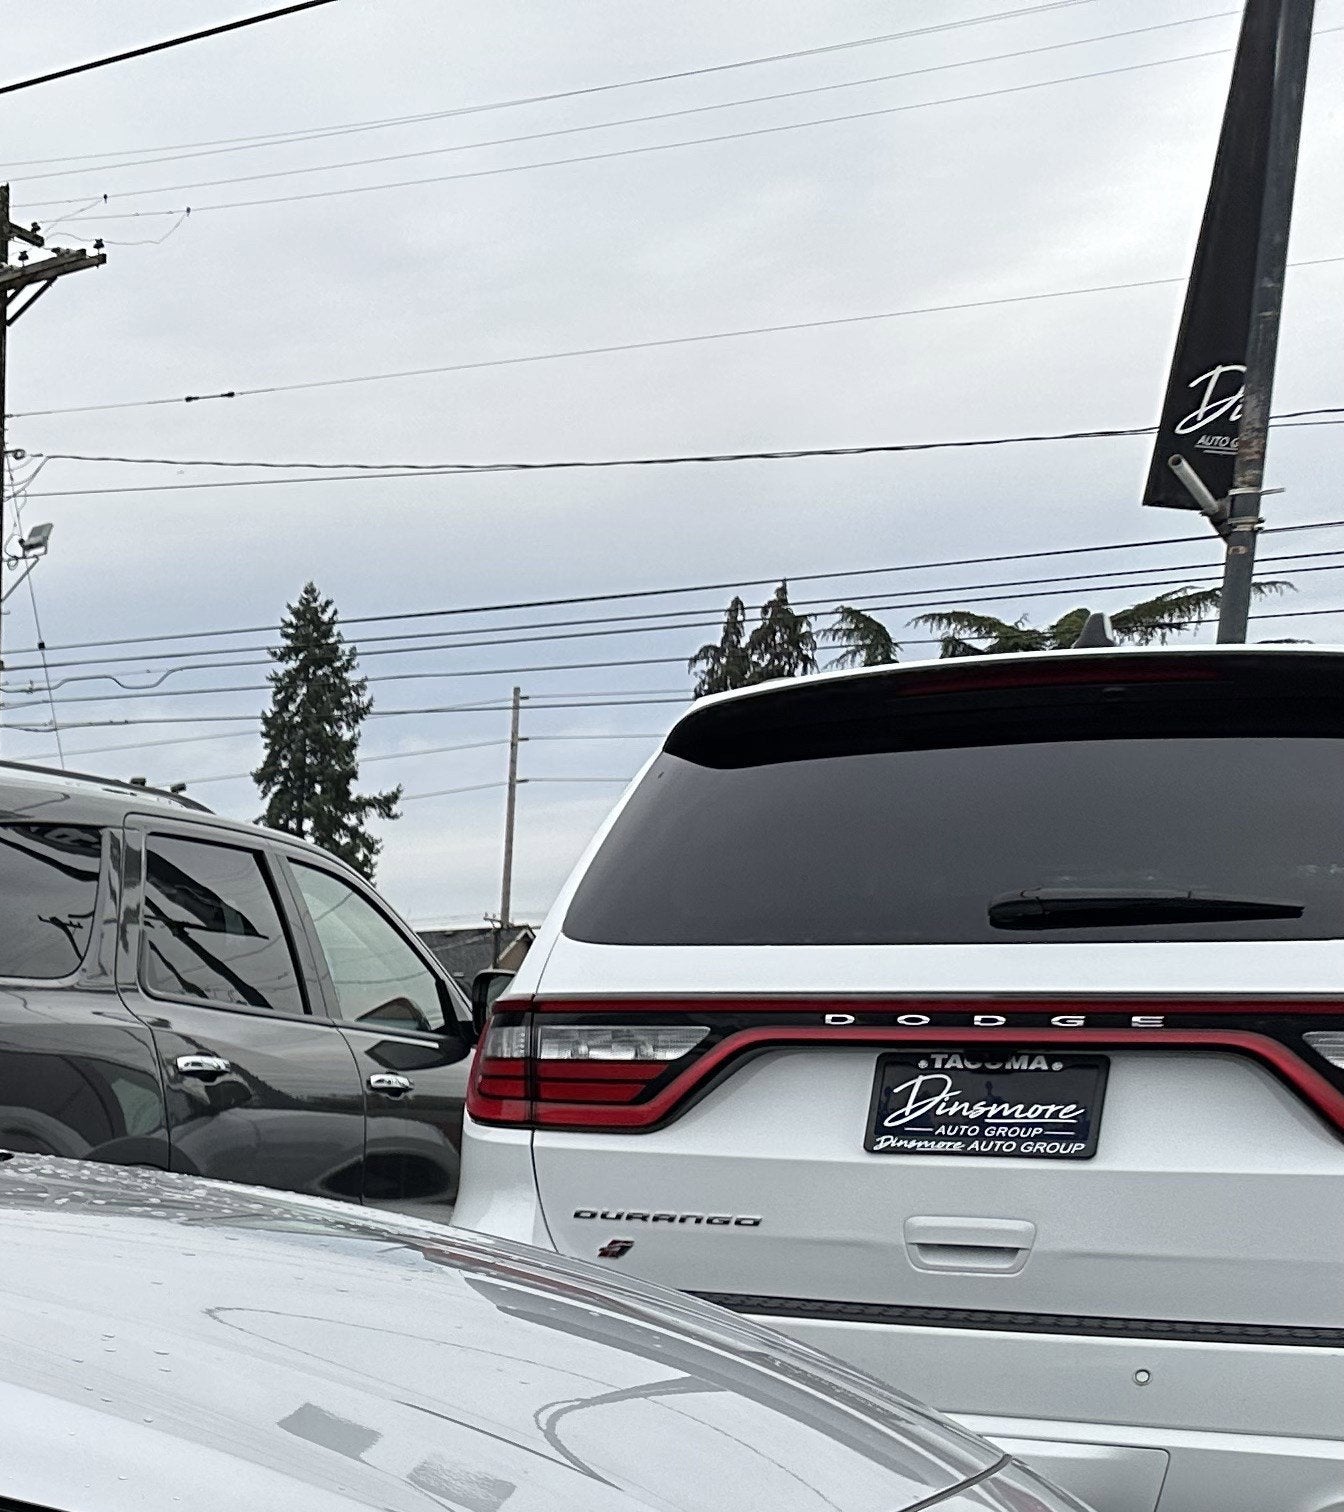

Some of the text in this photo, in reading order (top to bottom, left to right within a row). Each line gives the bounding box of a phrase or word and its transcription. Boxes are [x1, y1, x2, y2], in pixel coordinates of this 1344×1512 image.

[825, 1014, 1164, 1027] DODGE
[884, 1074, 1085, 1127] Dinsmore
[935, 1125, 1044, 1138] AUTO GROUP
[873, 1135, 1086, 1154] Dinsmore AUTO GROUP
[573, 1209, 762, 1227] DURANGO
